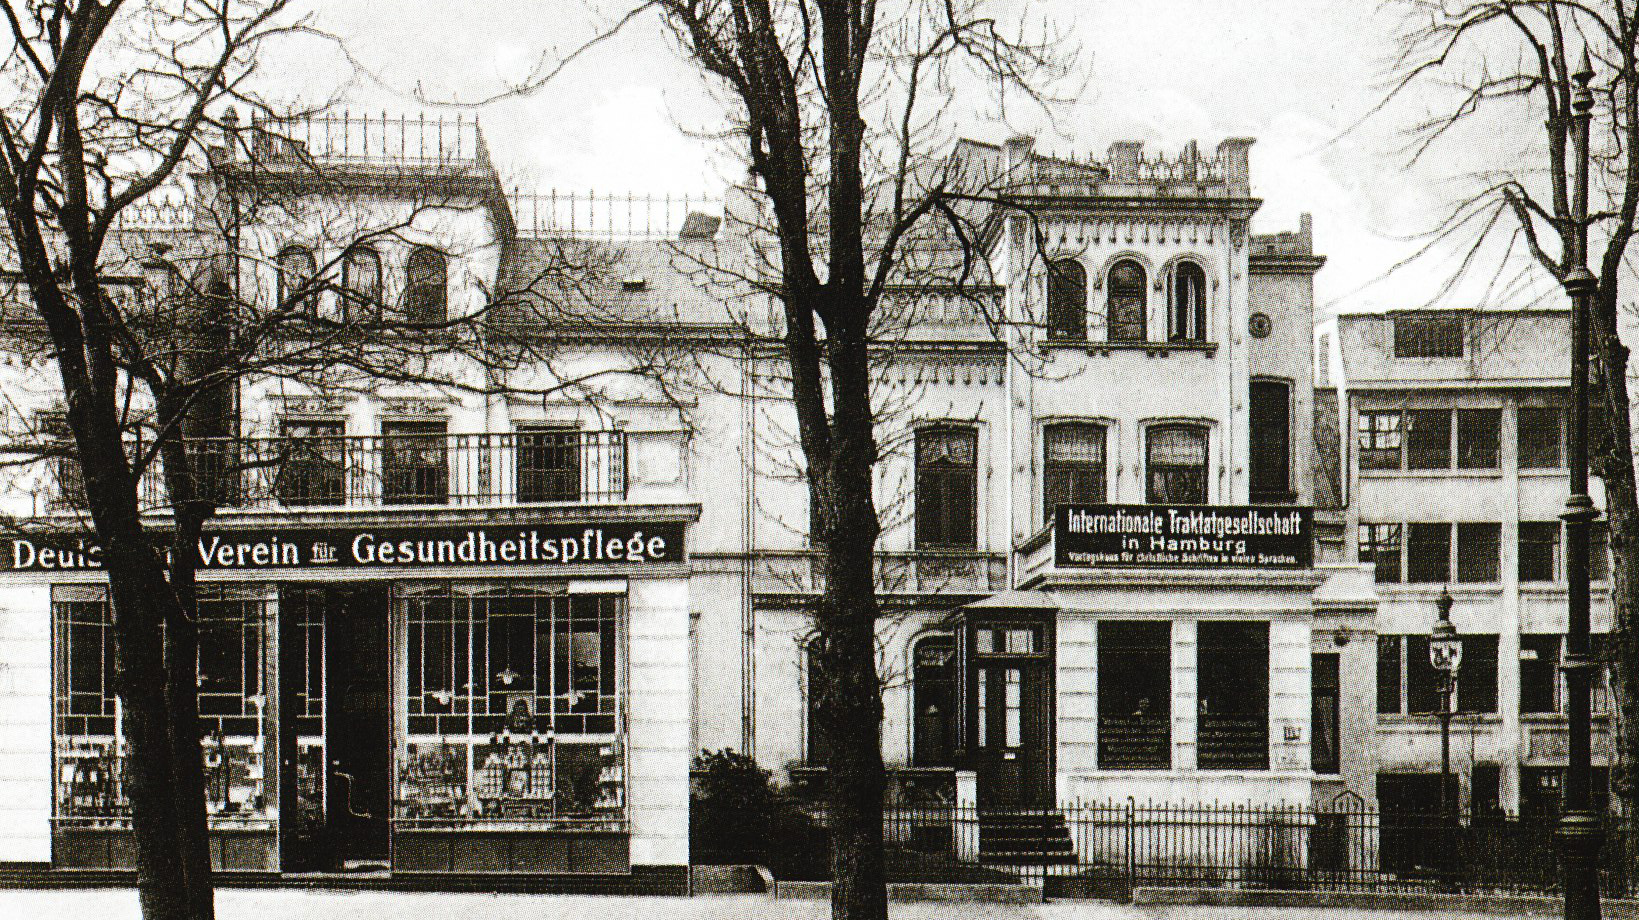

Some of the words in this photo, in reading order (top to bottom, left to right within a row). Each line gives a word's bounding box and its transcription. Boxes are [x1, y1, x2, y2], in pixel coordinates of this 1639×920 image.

[1069, 509, 1163, 534] Internationale
[1168, 509, 1302, 538] Traktatgesellschaft
[198, 536, 299, 566] Verein
[310, 541, 338, 563] für
[351, 529, 666, 563] Gesundheitspflege
[1122, 534, 1139, 550] in
[1150, 535, 1246, 554] Hamburg
